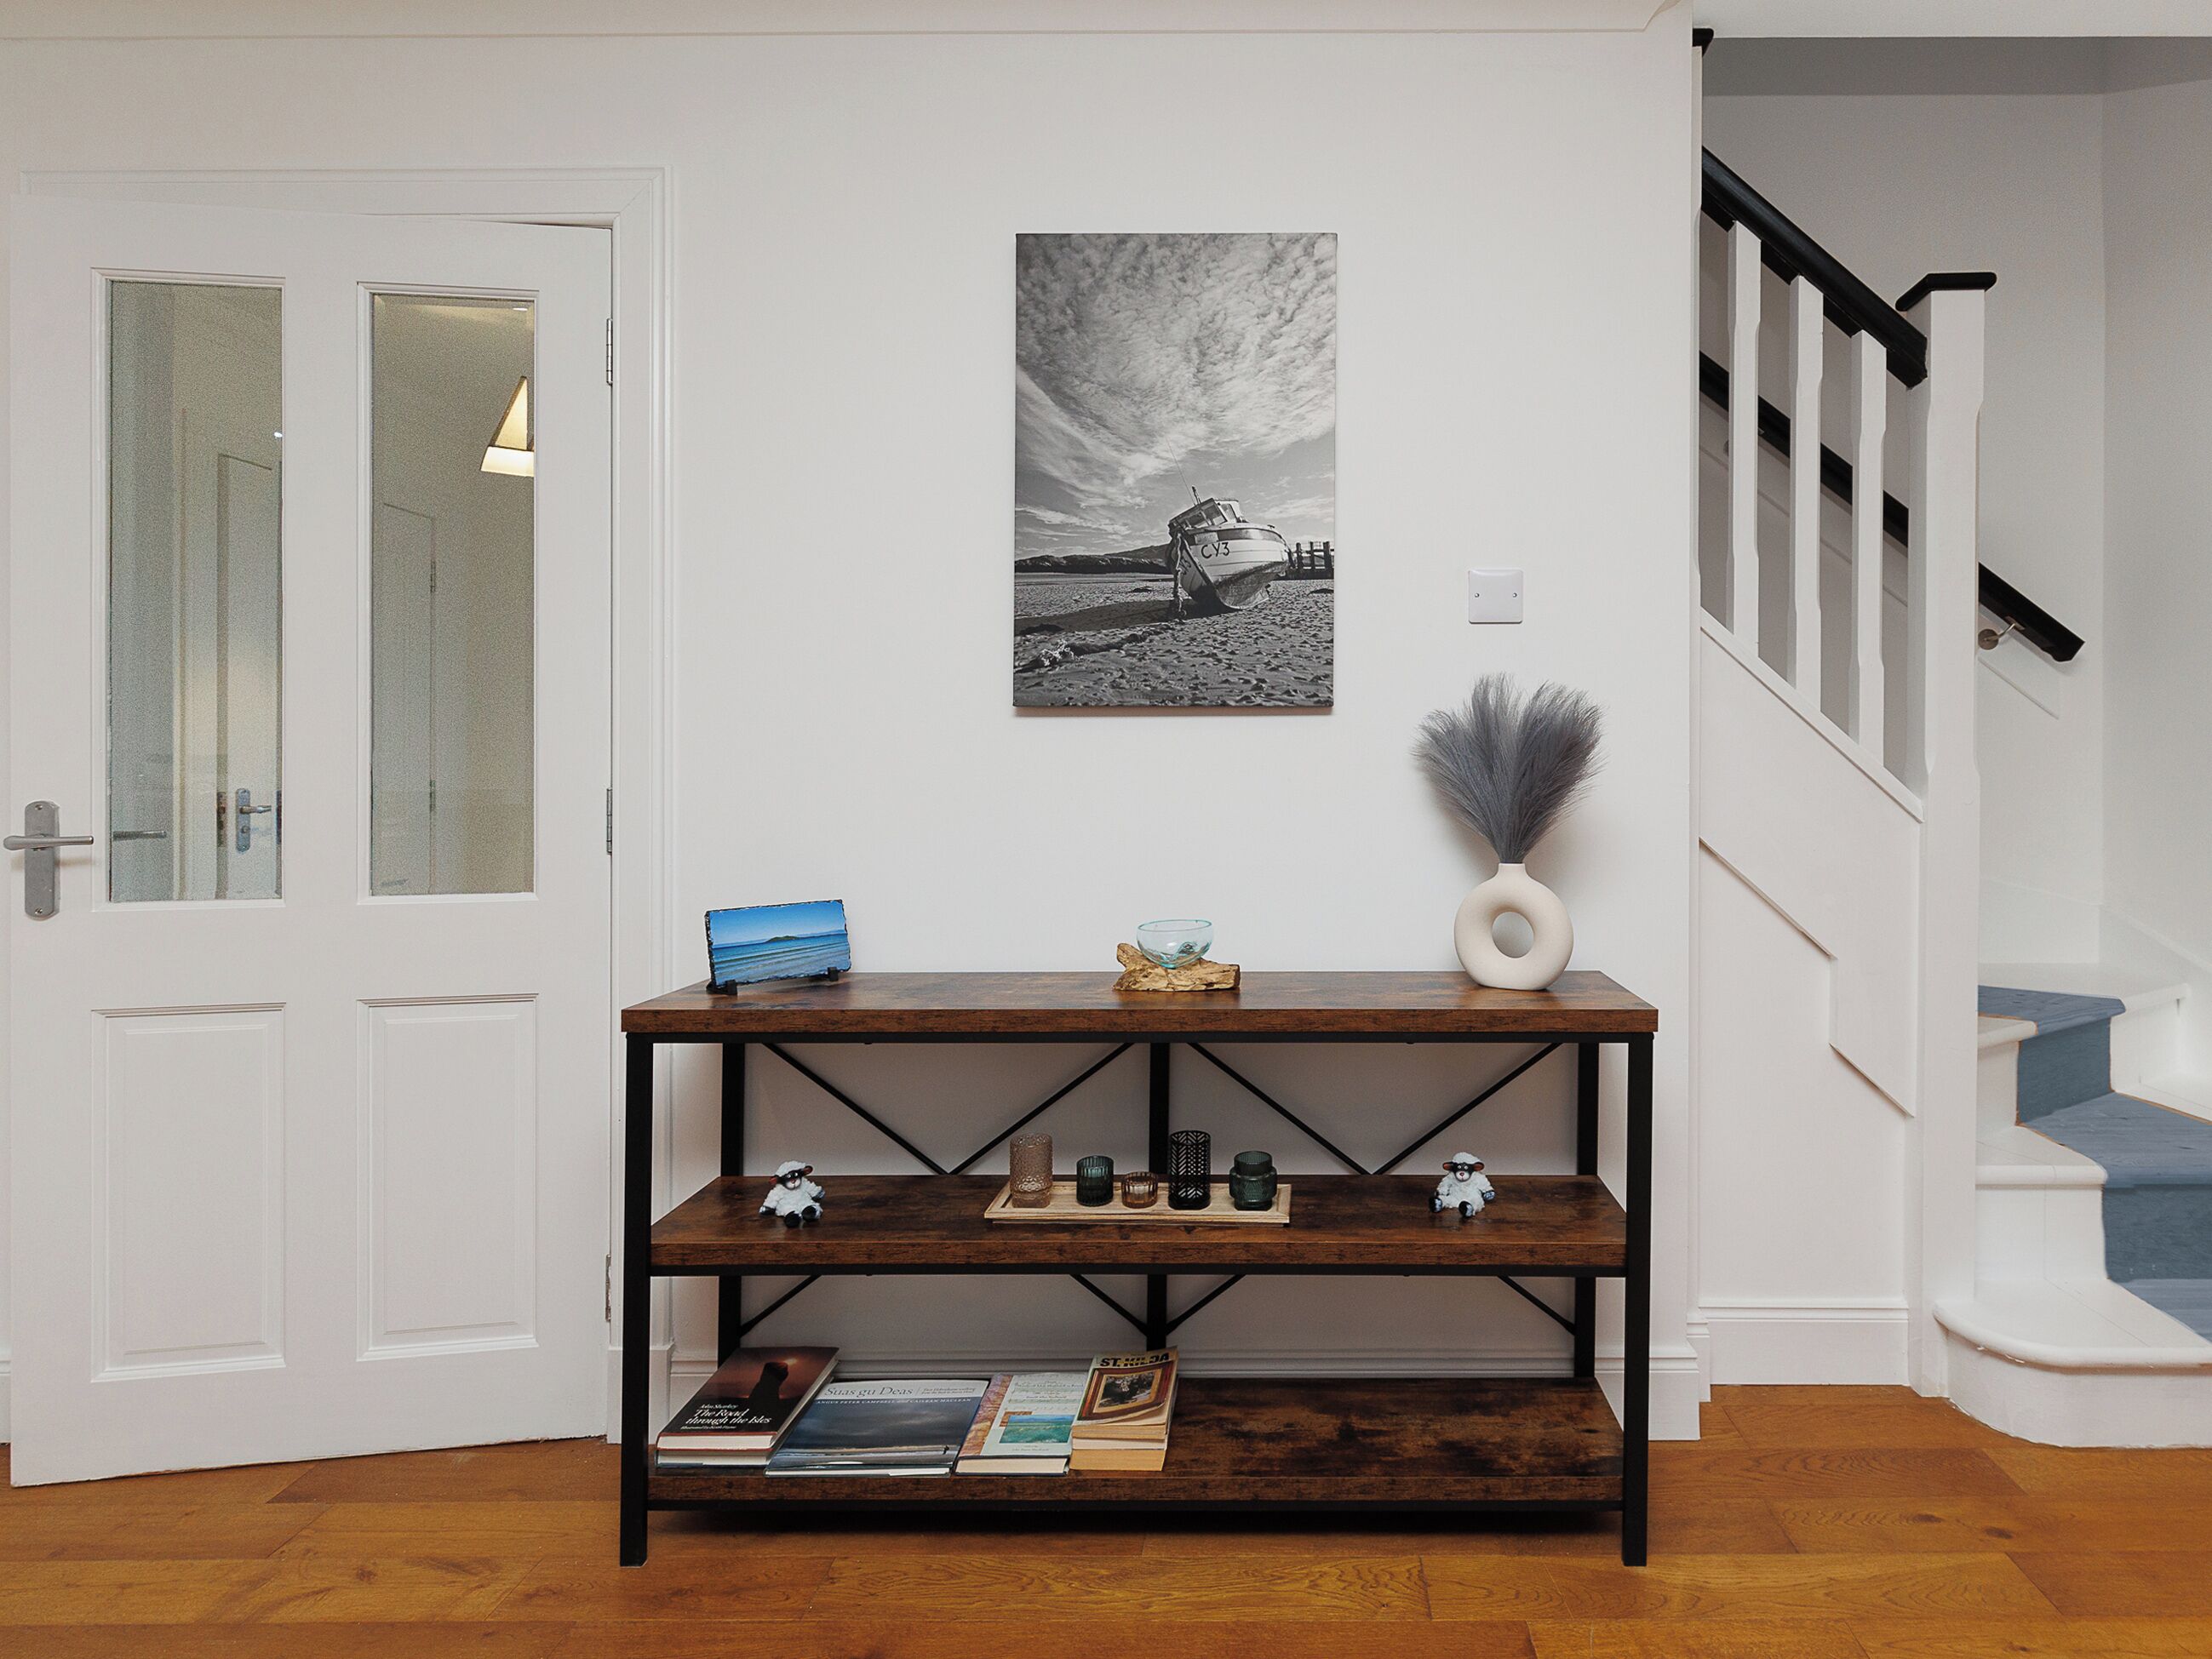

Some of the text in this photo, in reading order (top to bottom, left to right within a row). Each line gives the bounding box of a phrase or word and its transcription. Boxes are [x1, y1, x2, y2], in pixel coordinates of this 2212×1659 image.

[1201, 542, 1230, 559] CY3
[824, 1387, 914, 1398] Suas gu Deas
[694, 1408, 750, 1417] The Road
[685, 1415, 772, 1426] through the Isles
